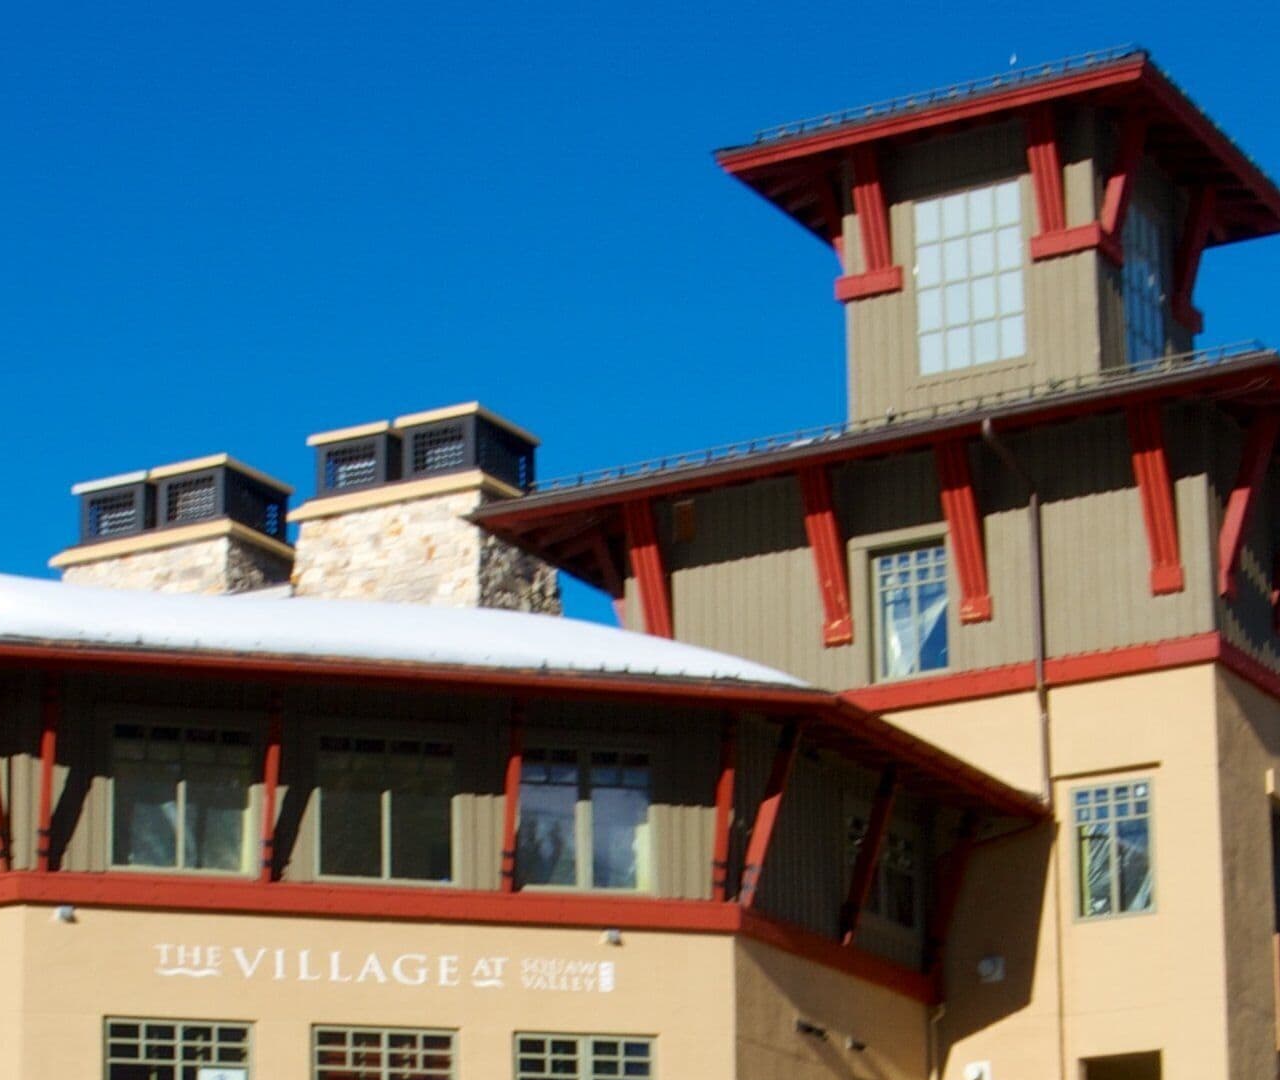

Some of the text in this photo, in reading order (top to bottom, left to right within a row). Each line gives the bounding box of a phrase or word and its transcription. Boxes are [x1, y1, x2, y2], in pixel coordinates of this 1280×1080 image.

[155, 943, 509, 987] THE VILLAGE AT
[521, 974, 597, 993] VALLEY
